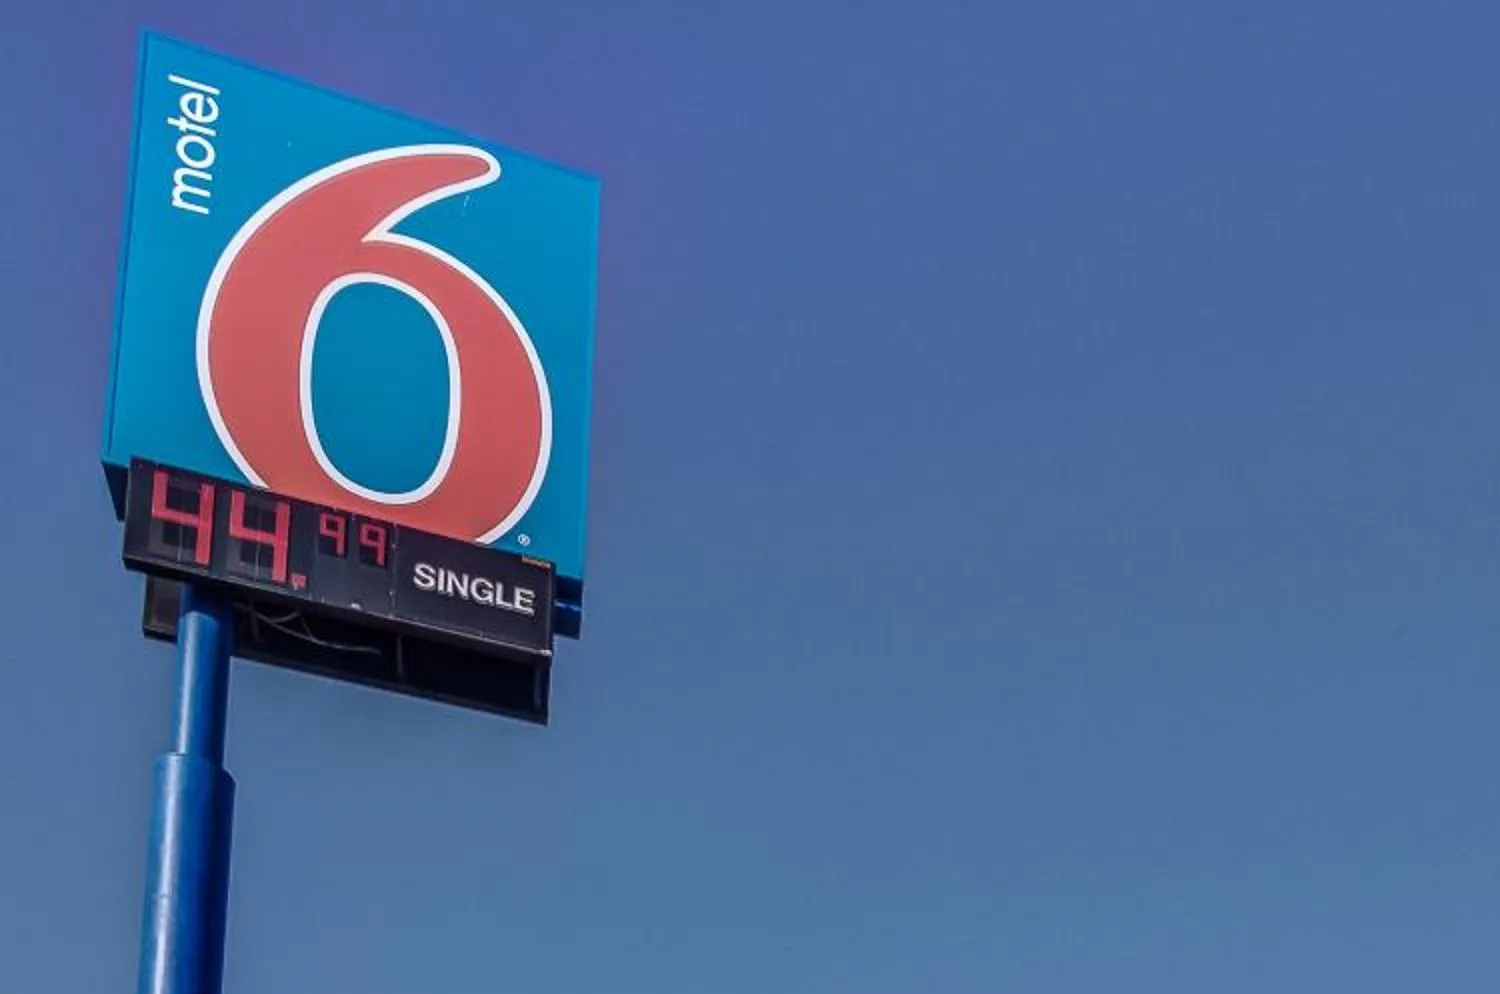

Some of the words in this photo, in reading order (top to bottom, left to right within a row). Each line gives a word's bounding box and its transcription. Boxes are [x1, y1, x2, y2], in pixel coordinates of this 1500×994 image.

[168, 74, 221, 215] motel
[196, 143, 553, 545] 6
[413, 562, 536, 616] SINGLE
